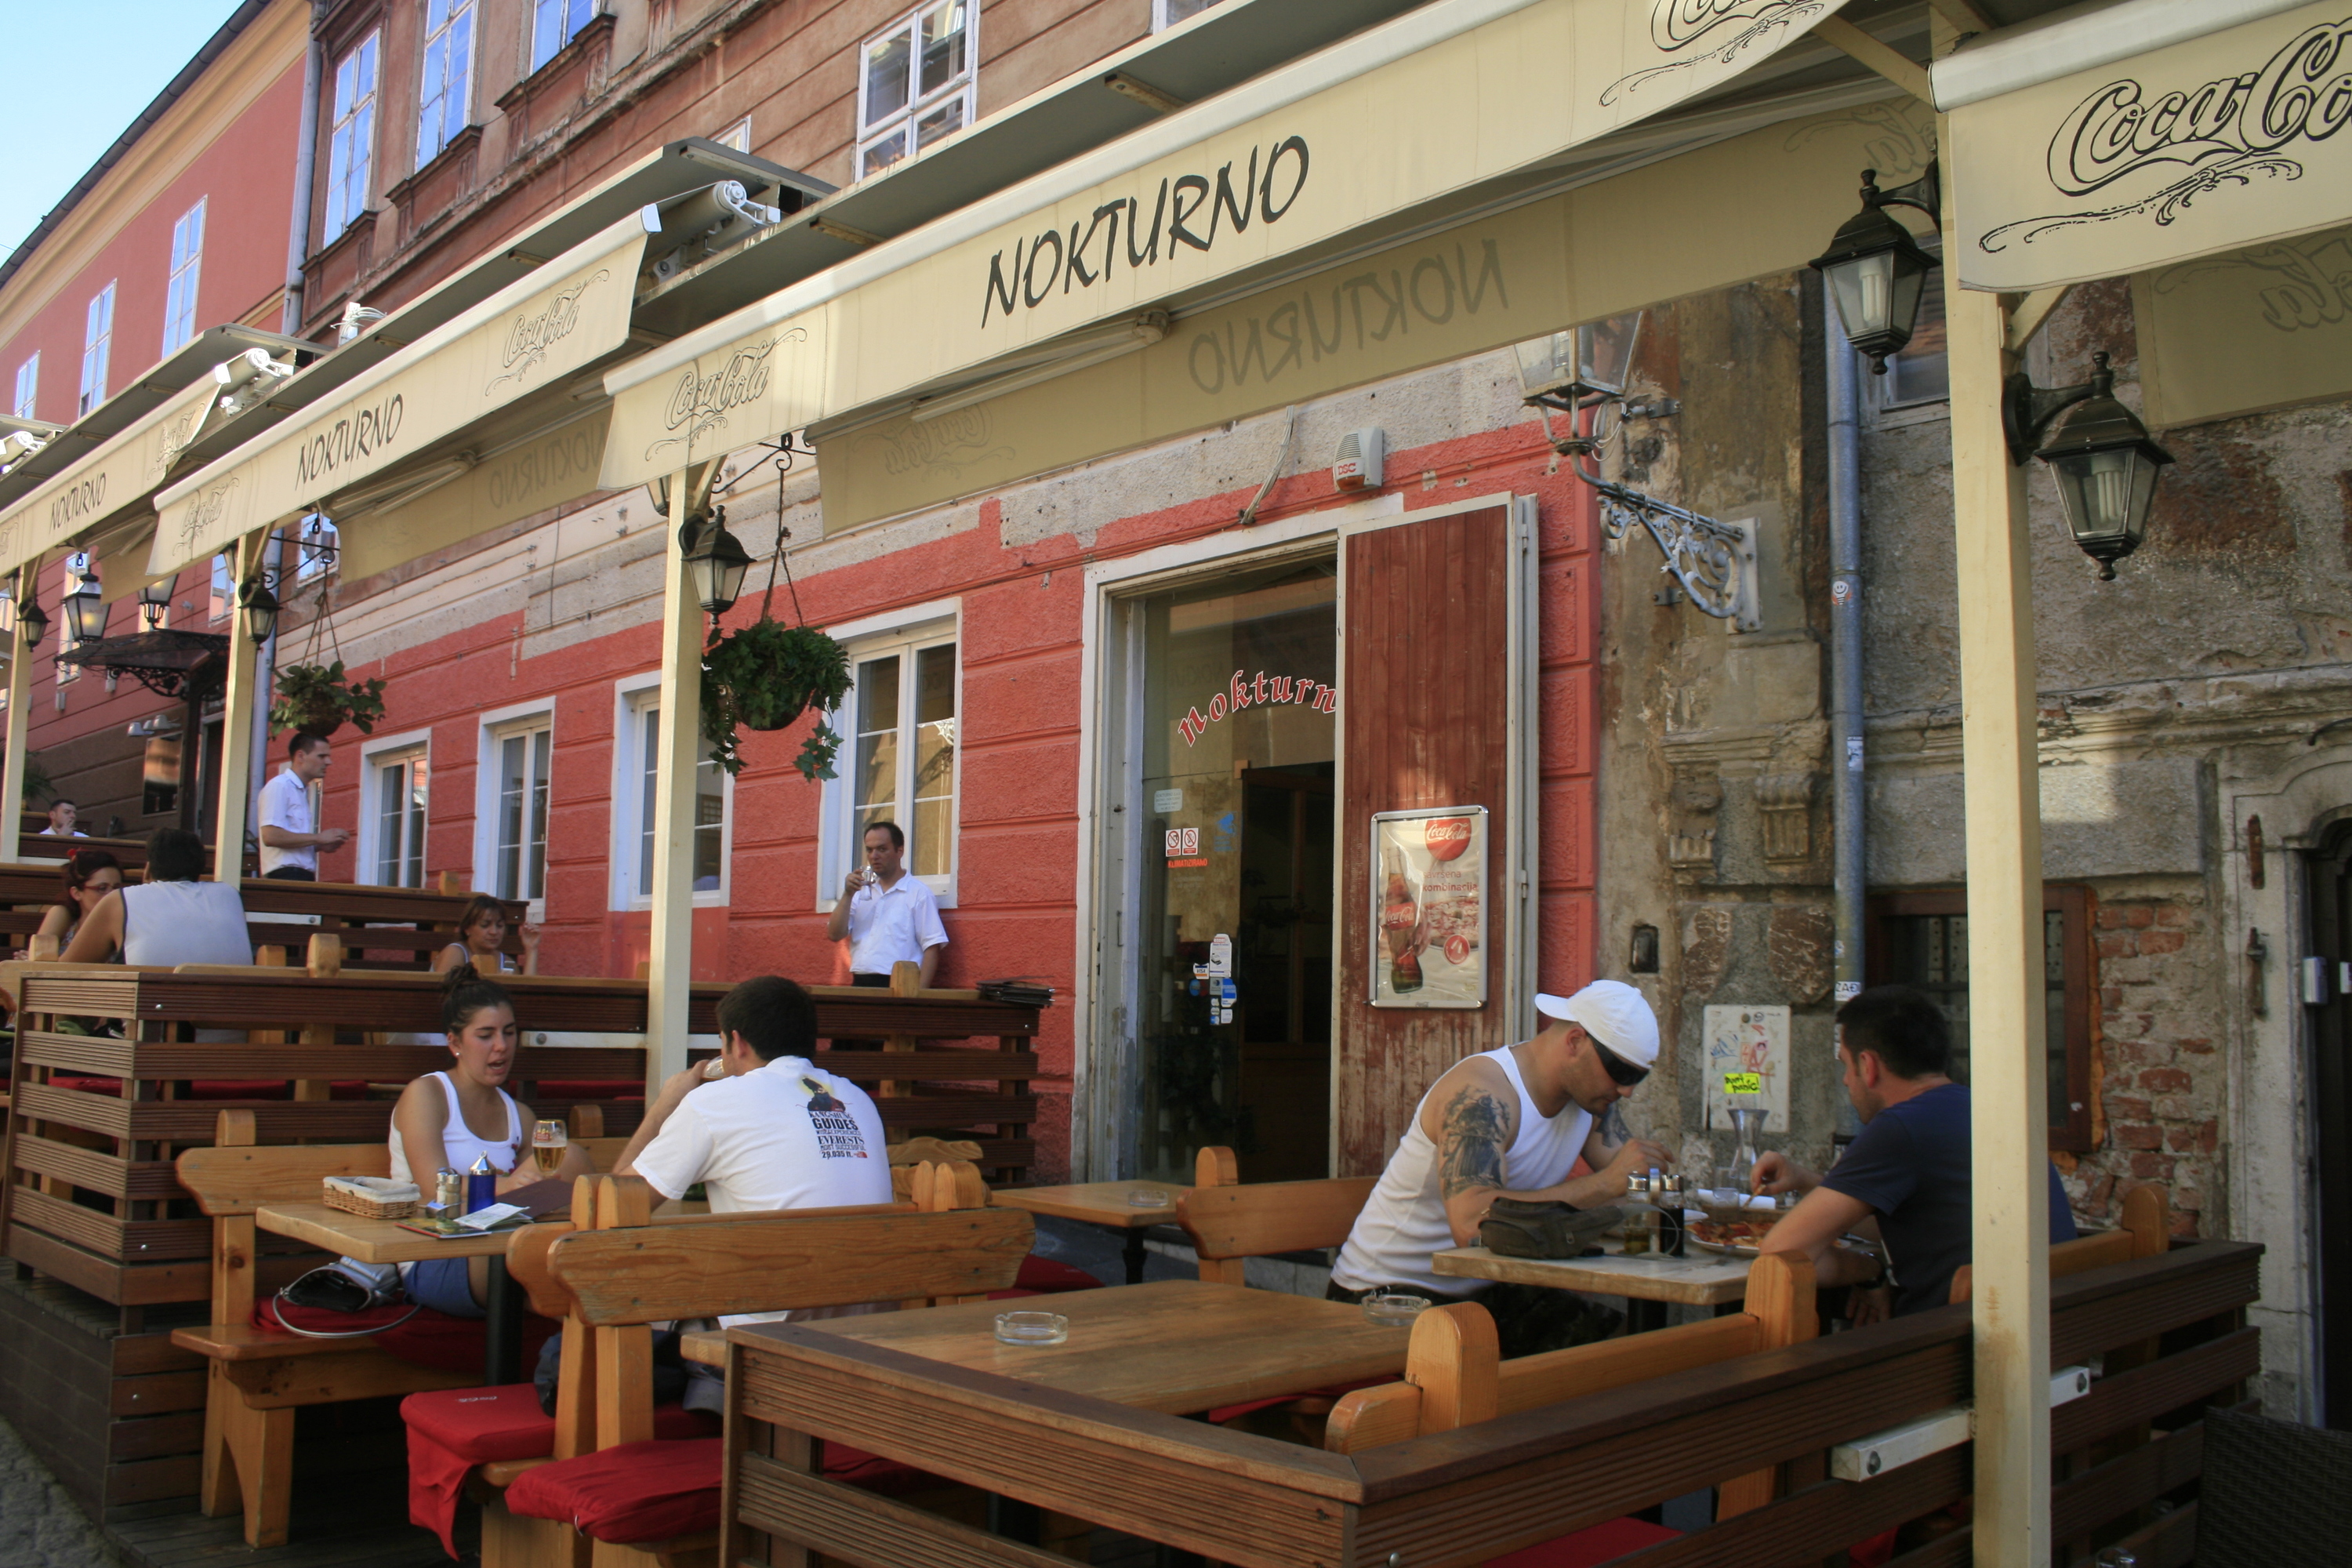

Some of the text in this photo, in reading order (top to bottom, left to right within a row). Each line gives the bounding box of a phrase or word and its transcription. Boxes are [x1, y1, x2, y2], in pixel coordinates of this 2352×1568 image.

[2046, 16, 2352, 197] Coca-Co
[982, 136, 1309, 328] NOKTURNO
[503, 281, 589, 368] Coca-Cola
[665, 338, 775, 430] Coca-Cola
[295, 394, 404, 491] NOKTURNO
[1338, 463, 1356, 475] DSC
[49, 472, 107, 535] NOKTURNO
[1178, 670, 1336, 747] nokturn
[1167, 858, 1208, 868] KLIMATIZIRANO
[1426, 822, 1469, 841] Coca-Cola
[1422, 882, 1479, 893] kombinacija
[812, 1118, 858, 1130] GUIDES
